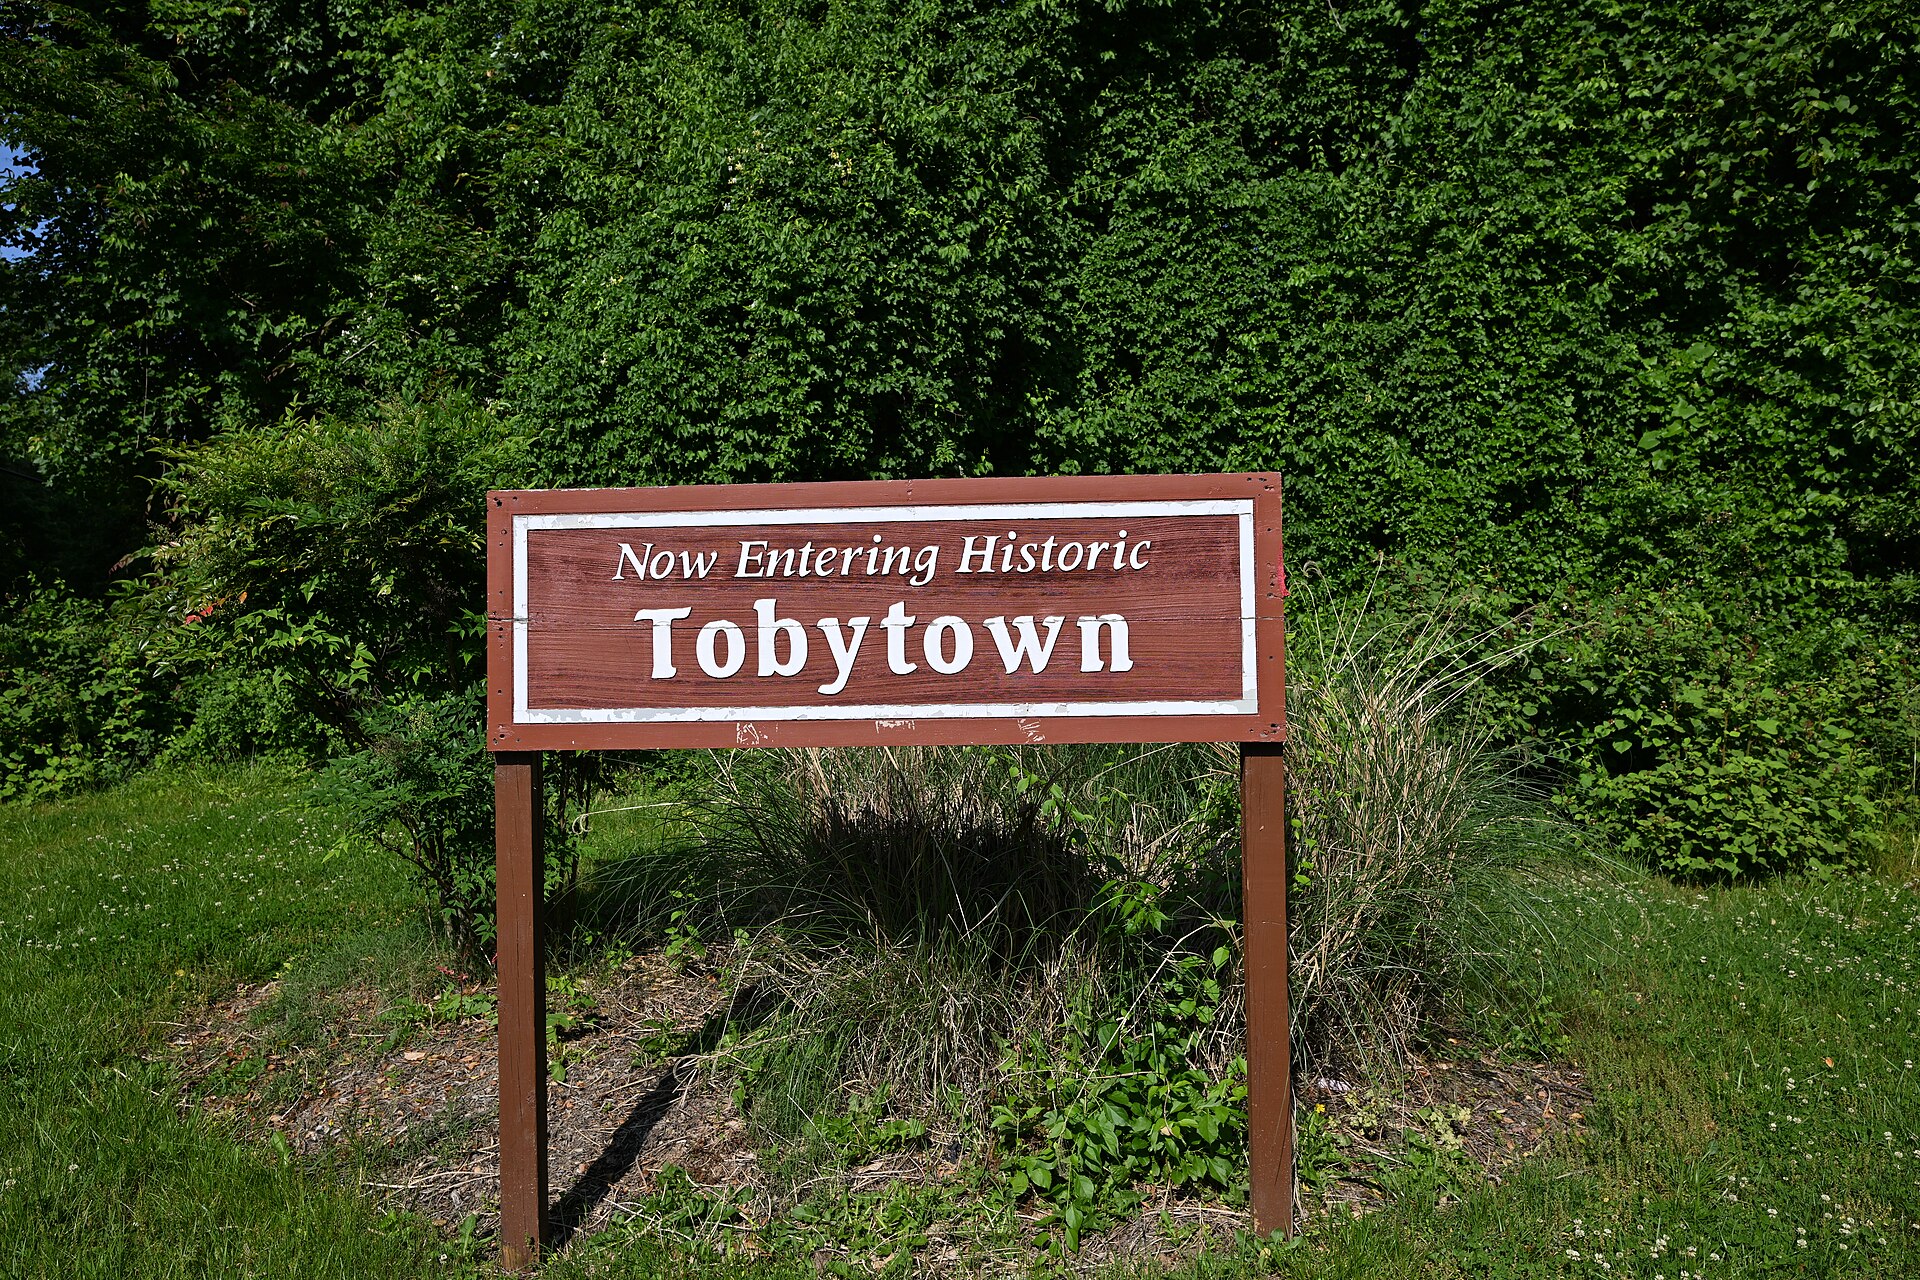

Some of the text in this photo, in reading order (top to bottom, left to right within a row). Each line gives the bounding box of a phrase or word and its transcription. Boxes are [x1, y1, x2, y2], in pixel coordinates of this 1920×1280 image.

[611, 529, 1152, 586] Now Entering Historic
[633, 598, 1134, 695] Tobytown
